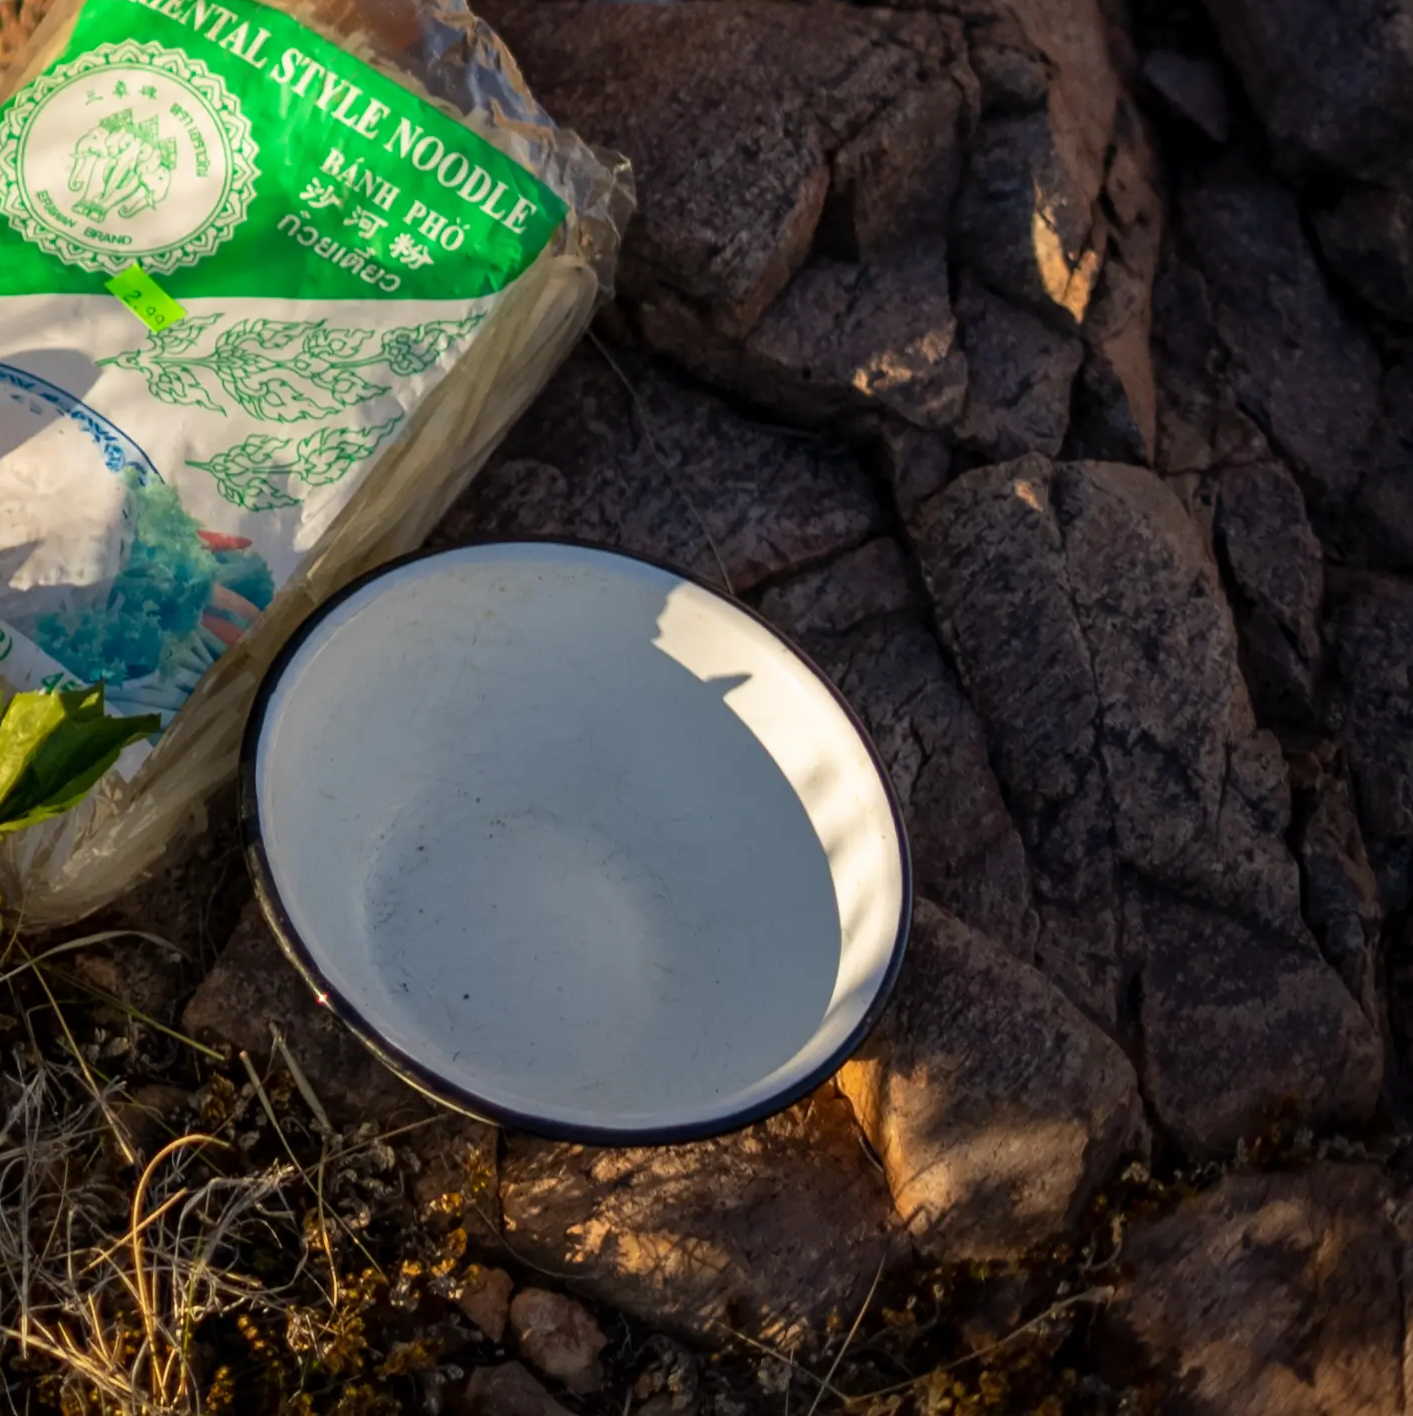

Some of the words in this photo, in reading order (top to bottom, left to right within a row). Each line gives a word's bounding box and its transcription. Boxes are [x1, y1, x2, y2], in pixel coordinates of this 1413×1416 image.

[271, 47, 391, 140] STYLE
[383, 116, 539, 235] NOODLE
[320, 147, 401, 212] BÁNH
[84, 227, 133, 245] BRAND
[299, 177, 435, 270] 沙河粉
